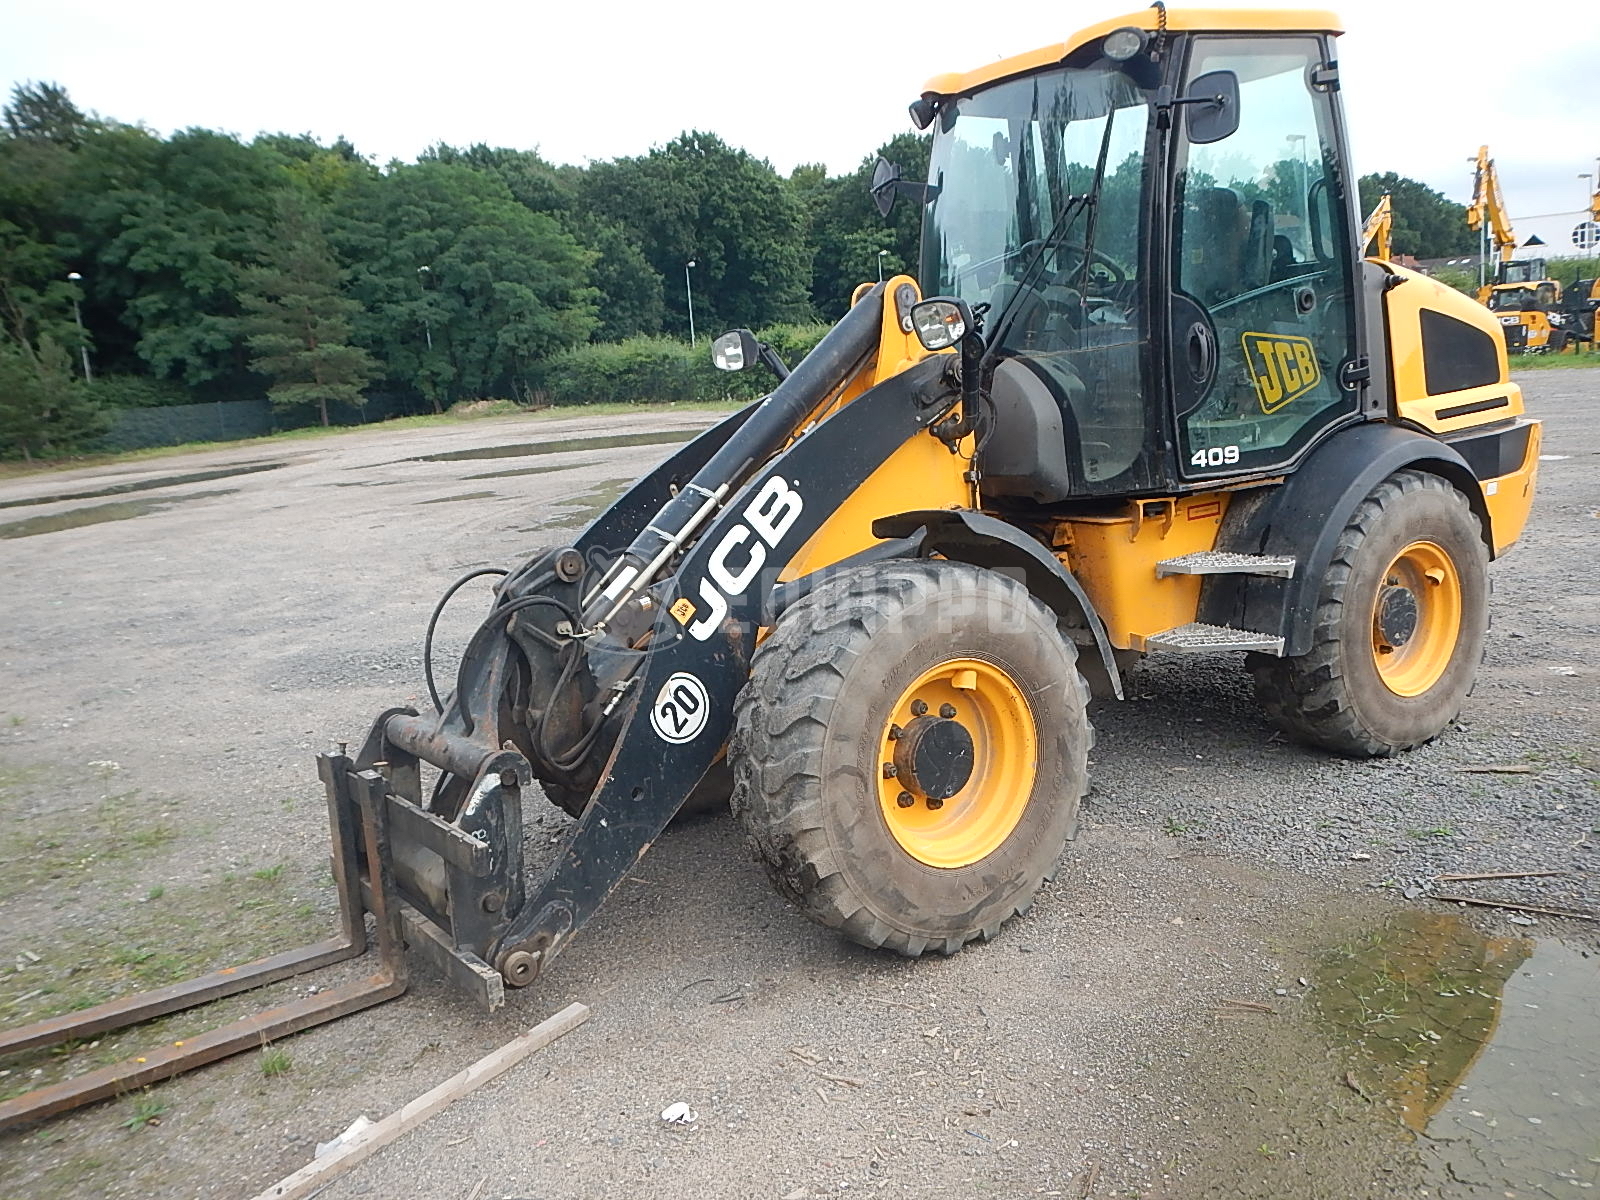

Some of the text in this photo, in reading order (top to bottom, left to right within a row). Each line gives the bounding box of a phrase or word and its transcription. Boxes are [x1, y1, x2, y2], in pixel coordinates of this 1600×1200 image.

[1256, 340, 1315, 404] JCB
[1190, 445, 1240, 468] 409
[687, 475, 803, 642] JCB
[660, 684, 700, 735] 20
